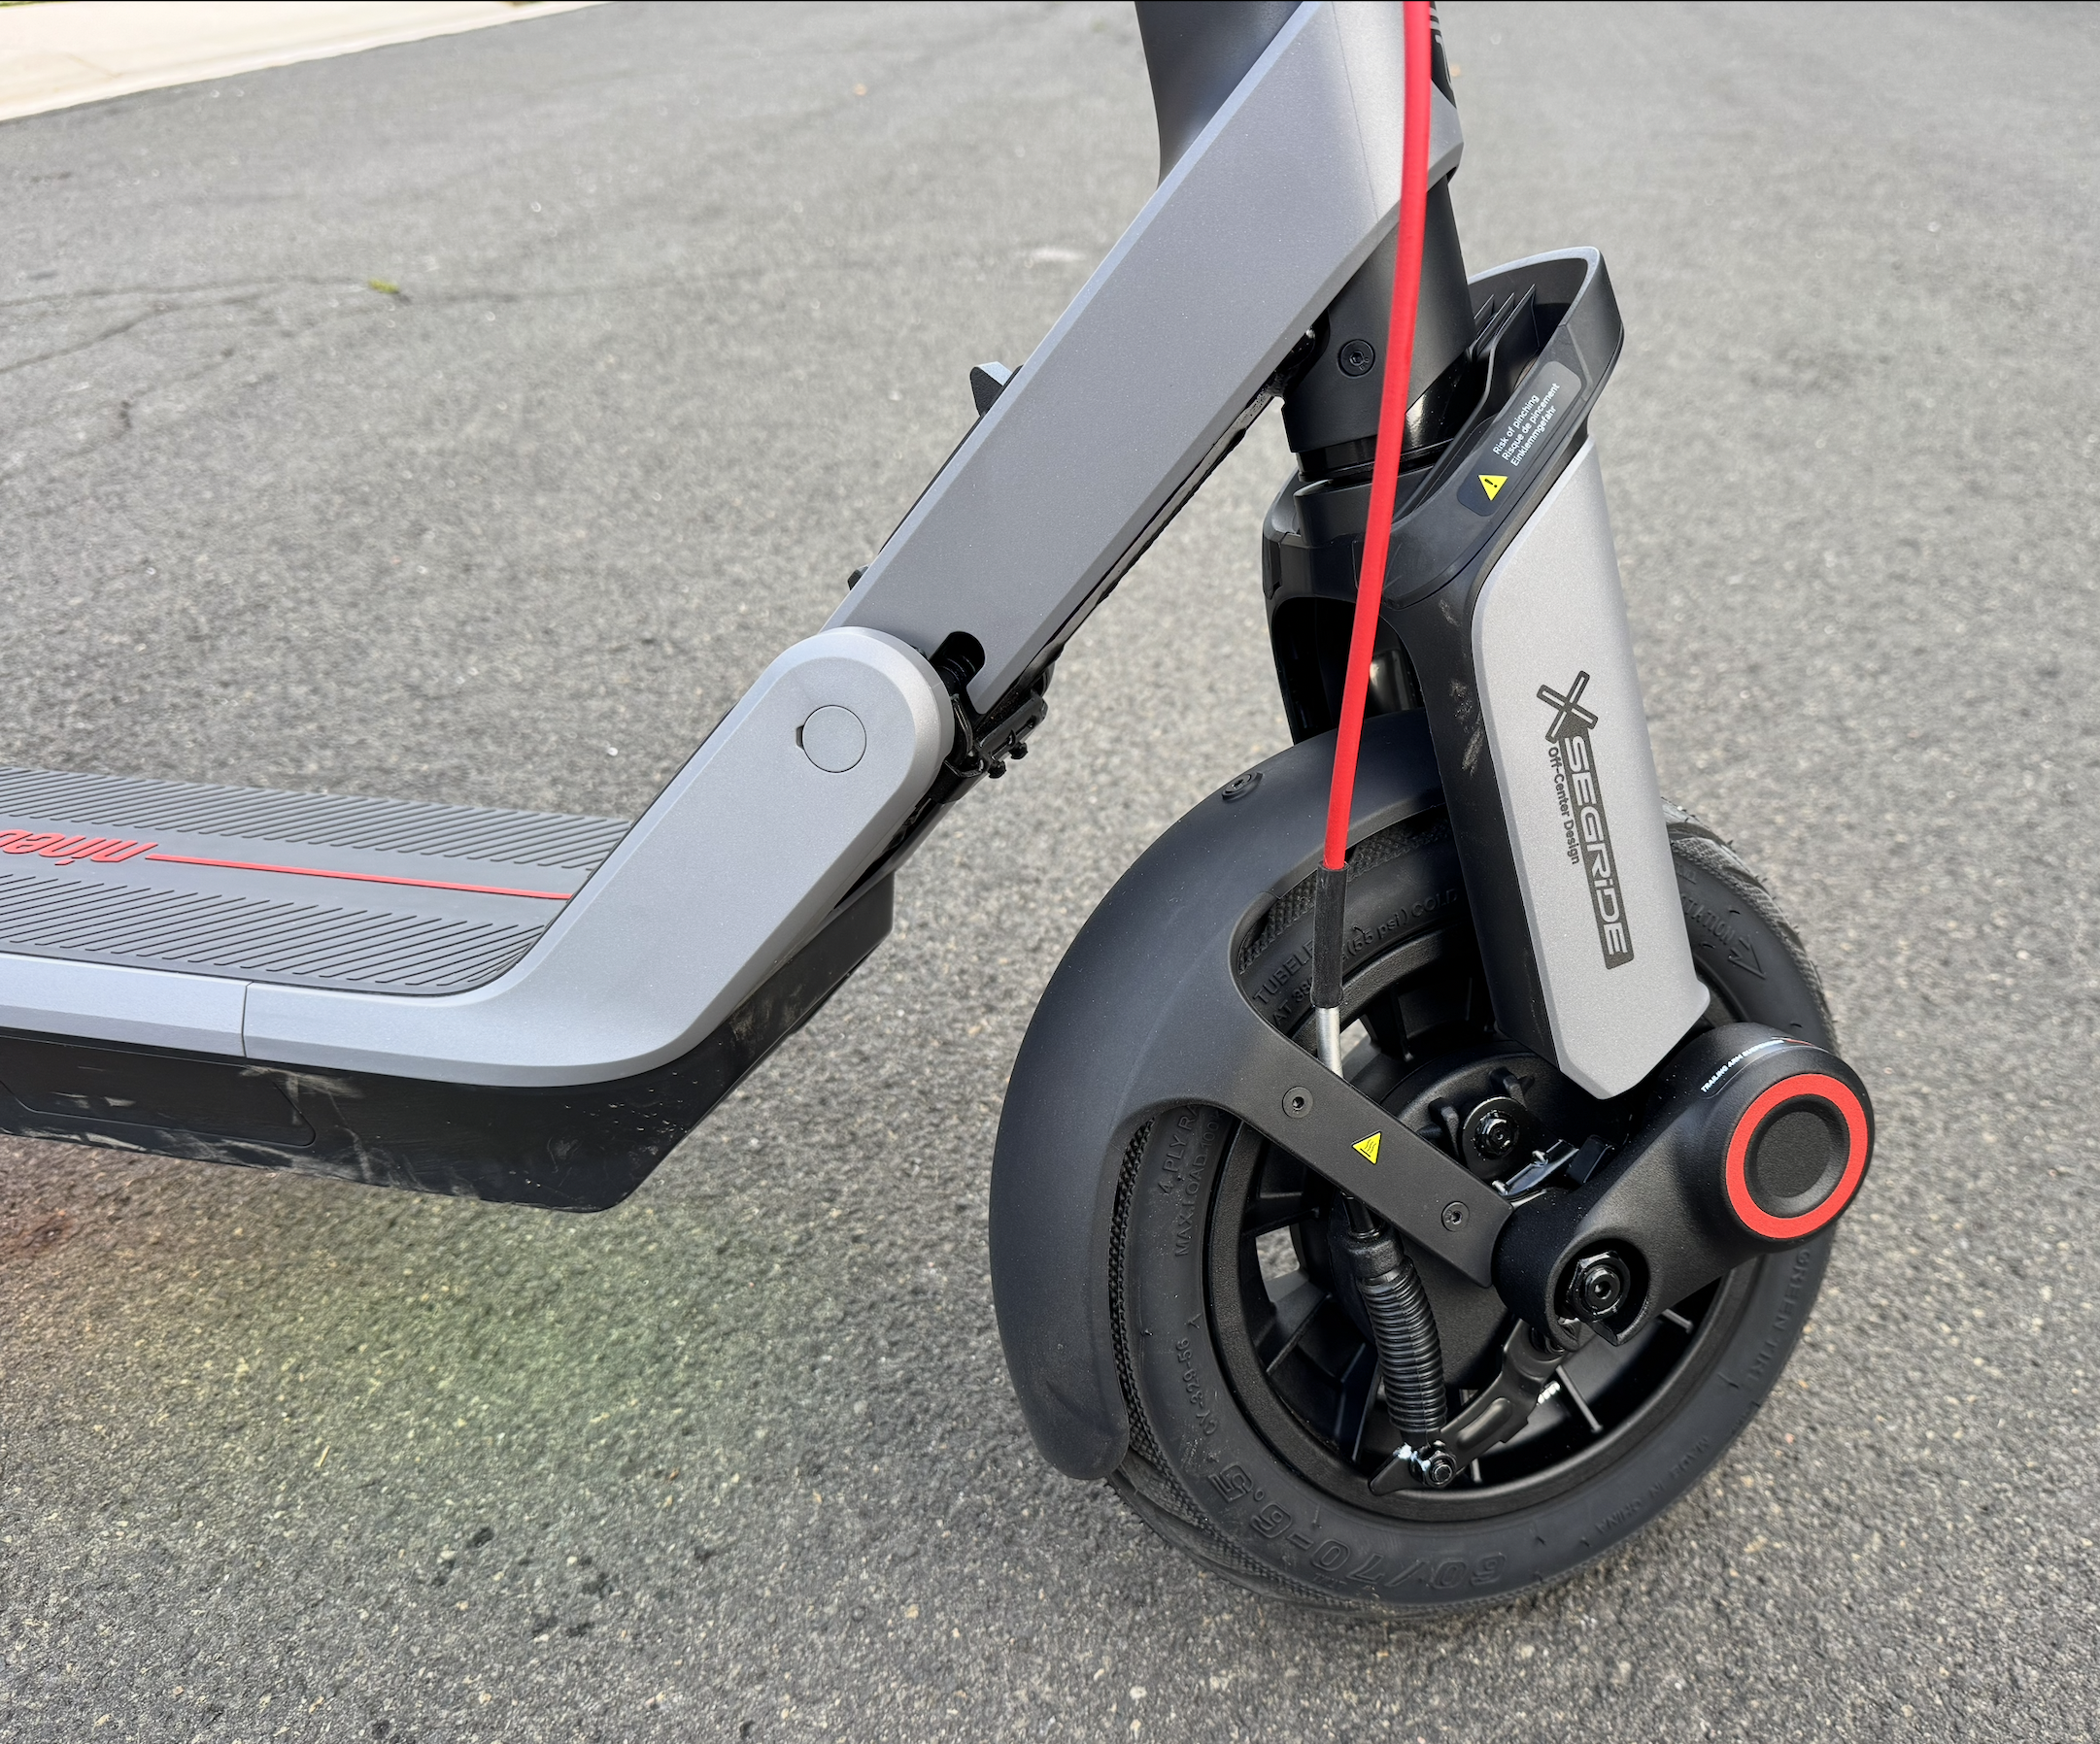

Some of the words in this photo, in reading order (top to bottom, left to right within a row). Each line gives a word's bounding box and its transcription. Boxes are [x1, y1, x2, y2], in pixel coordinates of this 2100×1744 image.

[1493, 437, 1508, 454] Risk
[1507, 426, 1515, 438] of
[1512, 394, 1540, 429] pinching
[1502, 433, 1524, 460] Risque
[1521, 422, 1532, 434] de
[1529, 383, 1560, 424] pincement
[1510, 405, 1557, 466] Einklemmgefahr
[1548, 746, 1571, 817] Off-Center
[1563, 819, 1580, 865] Design
[1681, 893, 1736, 946] TATION
[1272, 999, 1293, 1027] AT
[1164, 1134, 1187, 1172] PLY
[1207, 1462, 1507, 1590] 60/70-6.5
